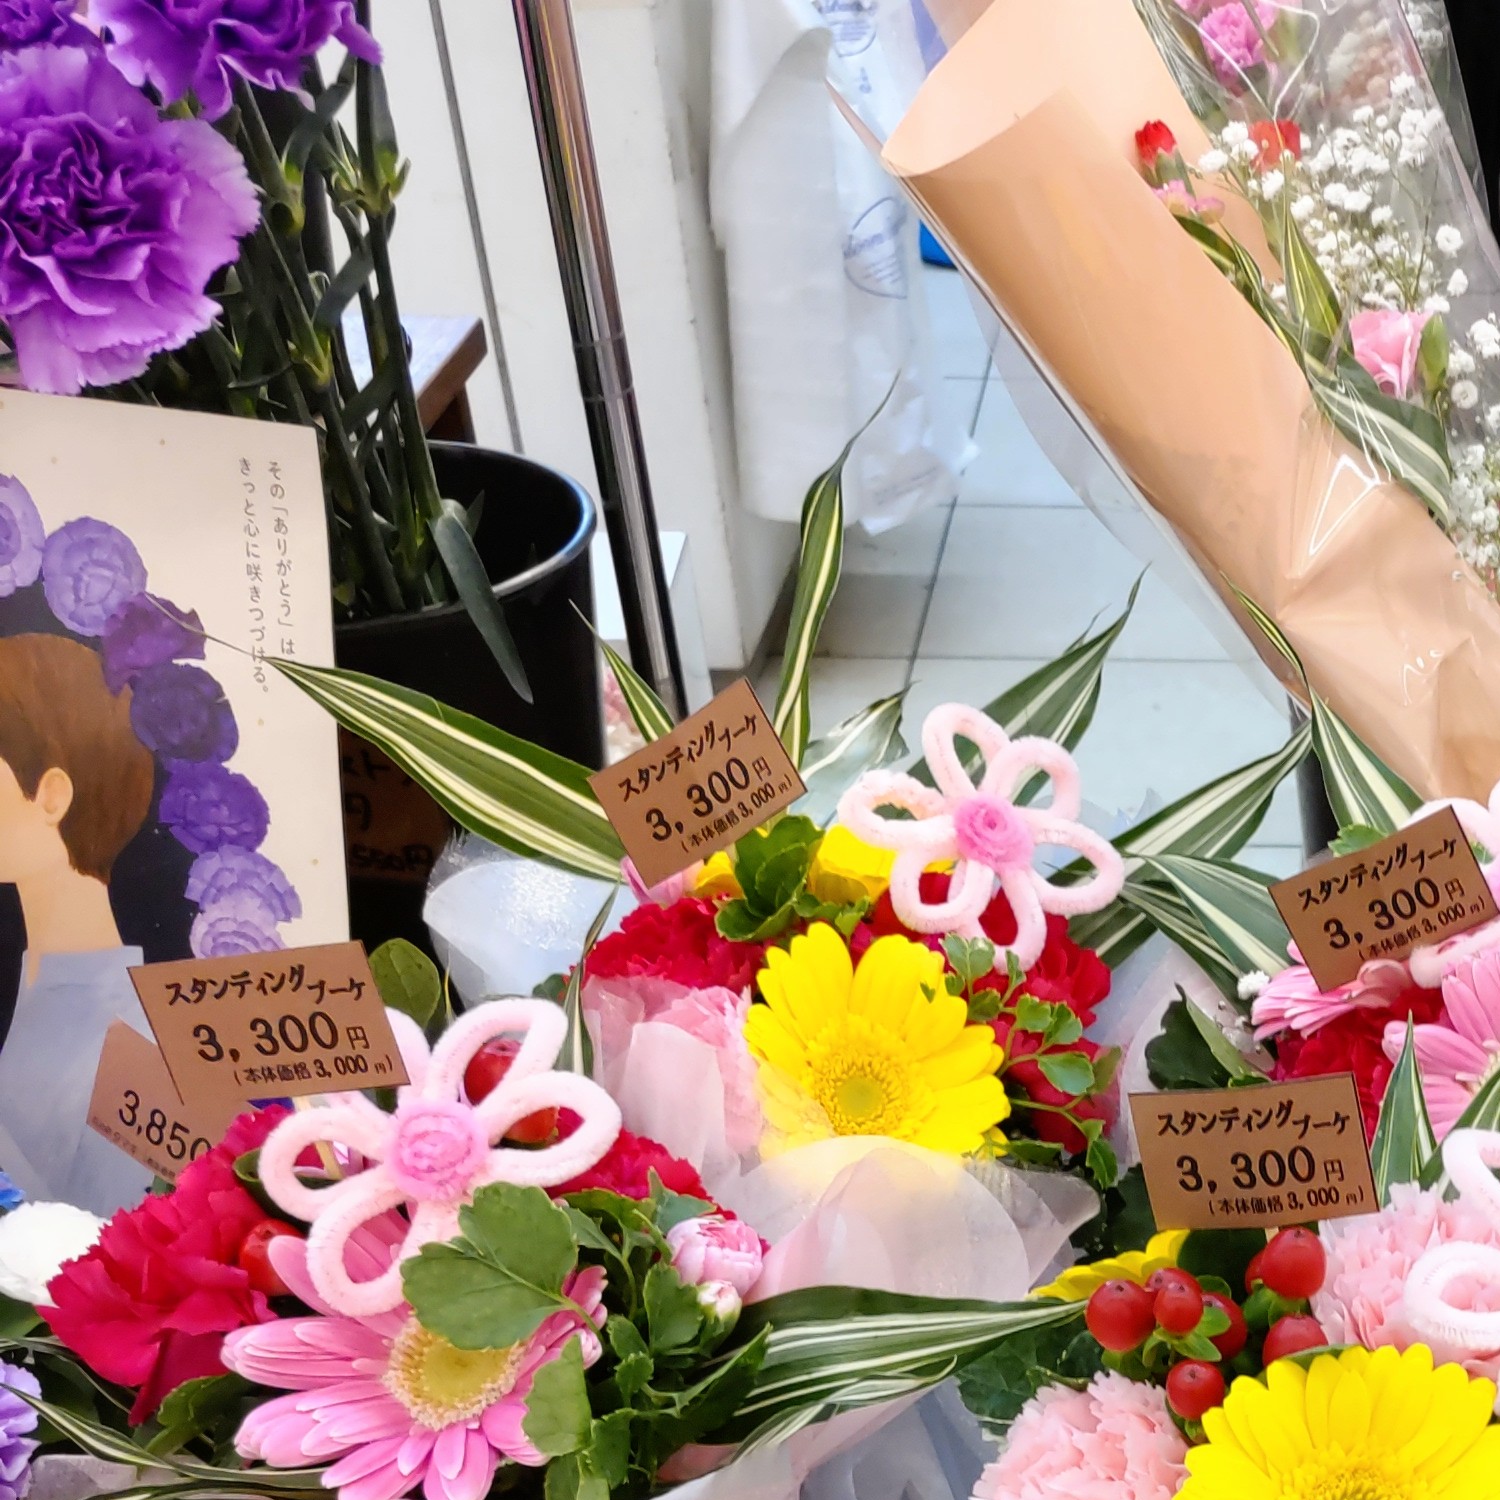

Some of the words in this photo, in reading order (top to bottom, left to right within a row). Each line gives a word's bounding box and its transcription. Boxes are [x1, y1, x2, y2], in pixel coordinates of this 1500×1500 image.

[267, 460, 296, 655] その「ありがとう」は
[645, 756, 772, 842] 3,300円
[1323, 876, 1465, 950] 3,300円
[192, 1010, 370, 1063] 3,300円
[1176, 1144, 1344, 1194] 3,300円
